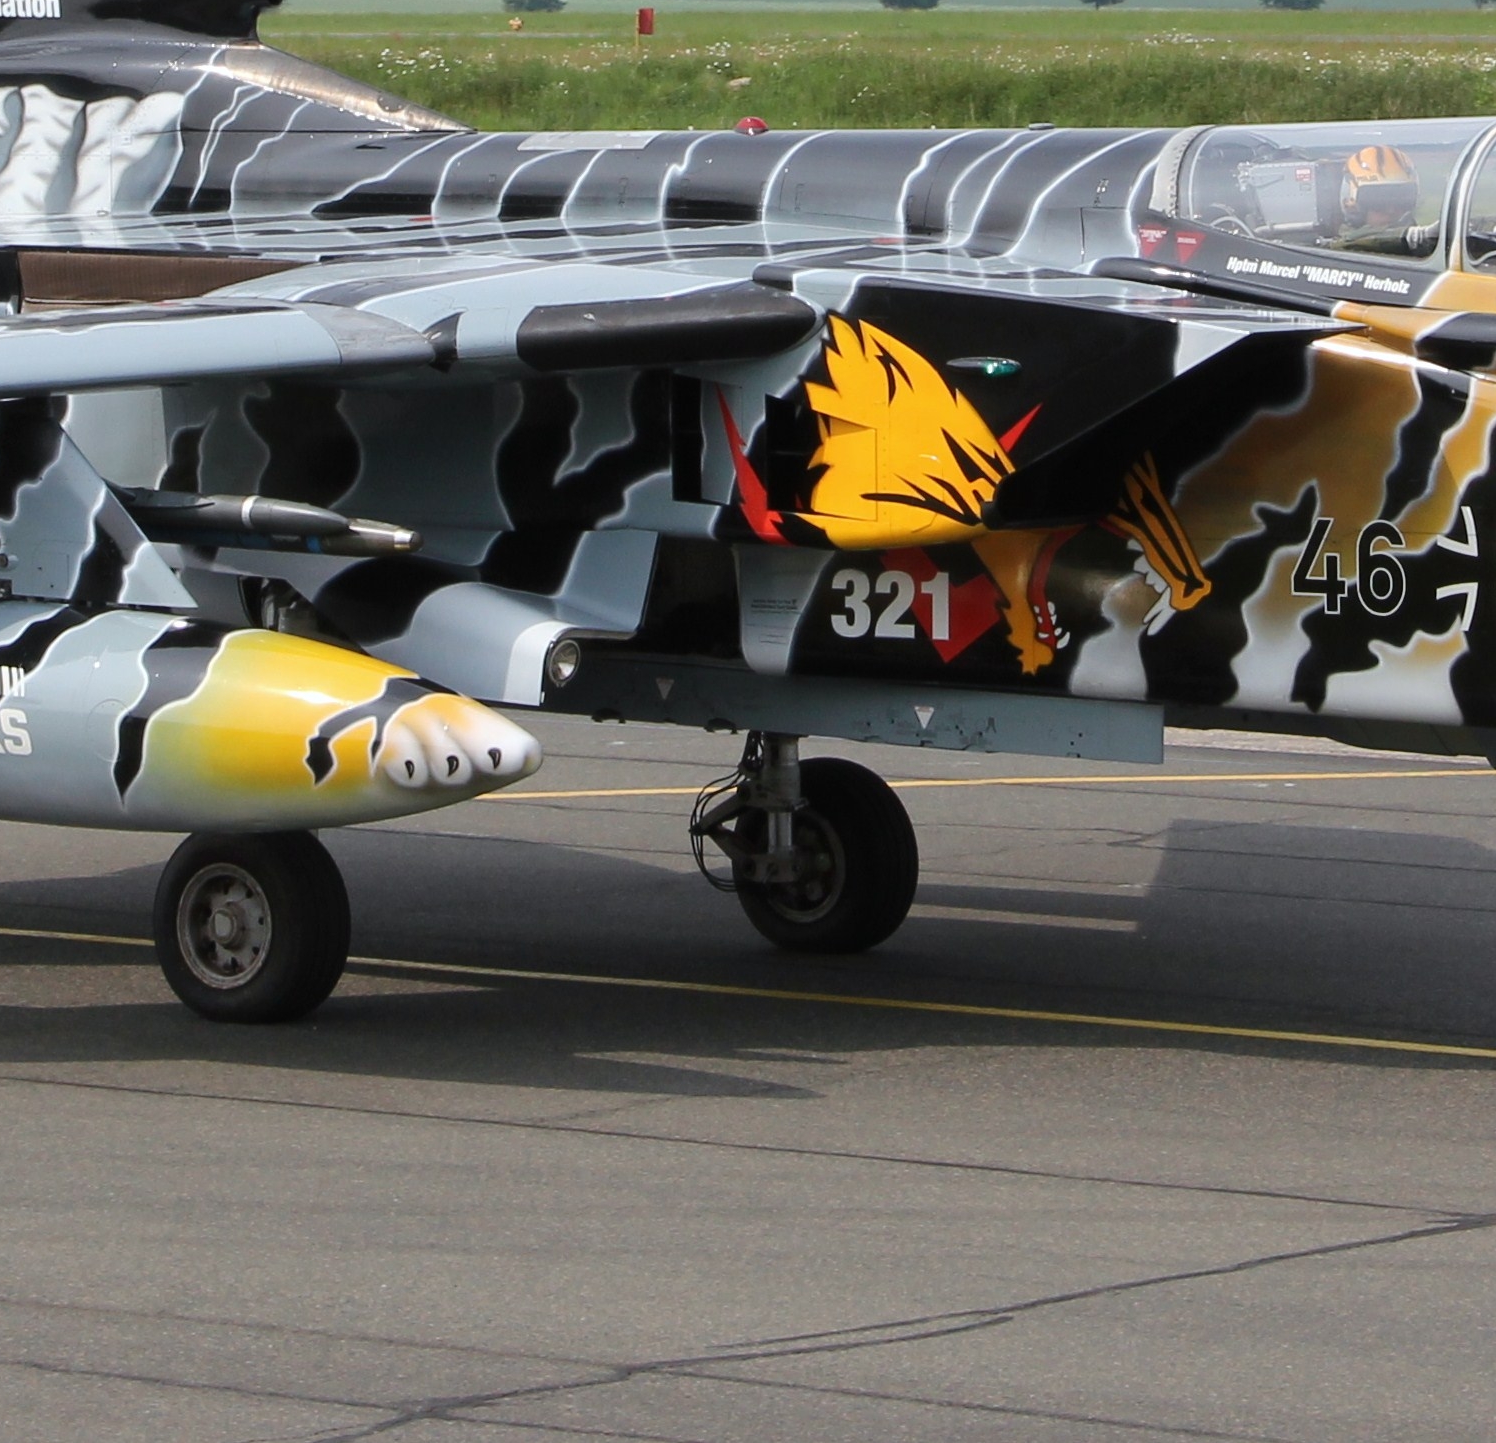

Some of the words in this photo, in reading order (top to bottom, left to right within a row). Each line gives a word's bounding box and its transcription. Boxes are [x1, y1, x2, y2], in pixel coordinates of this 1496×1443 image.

[1259, 260, 1300, 279] Marcel
[1302, 265, 1363, 288] "MARCY"
[1363, 274, 1411, 294] Herholz
[830, 567, 950, 641] 321
[1291, 518, 1407, 616] 46
